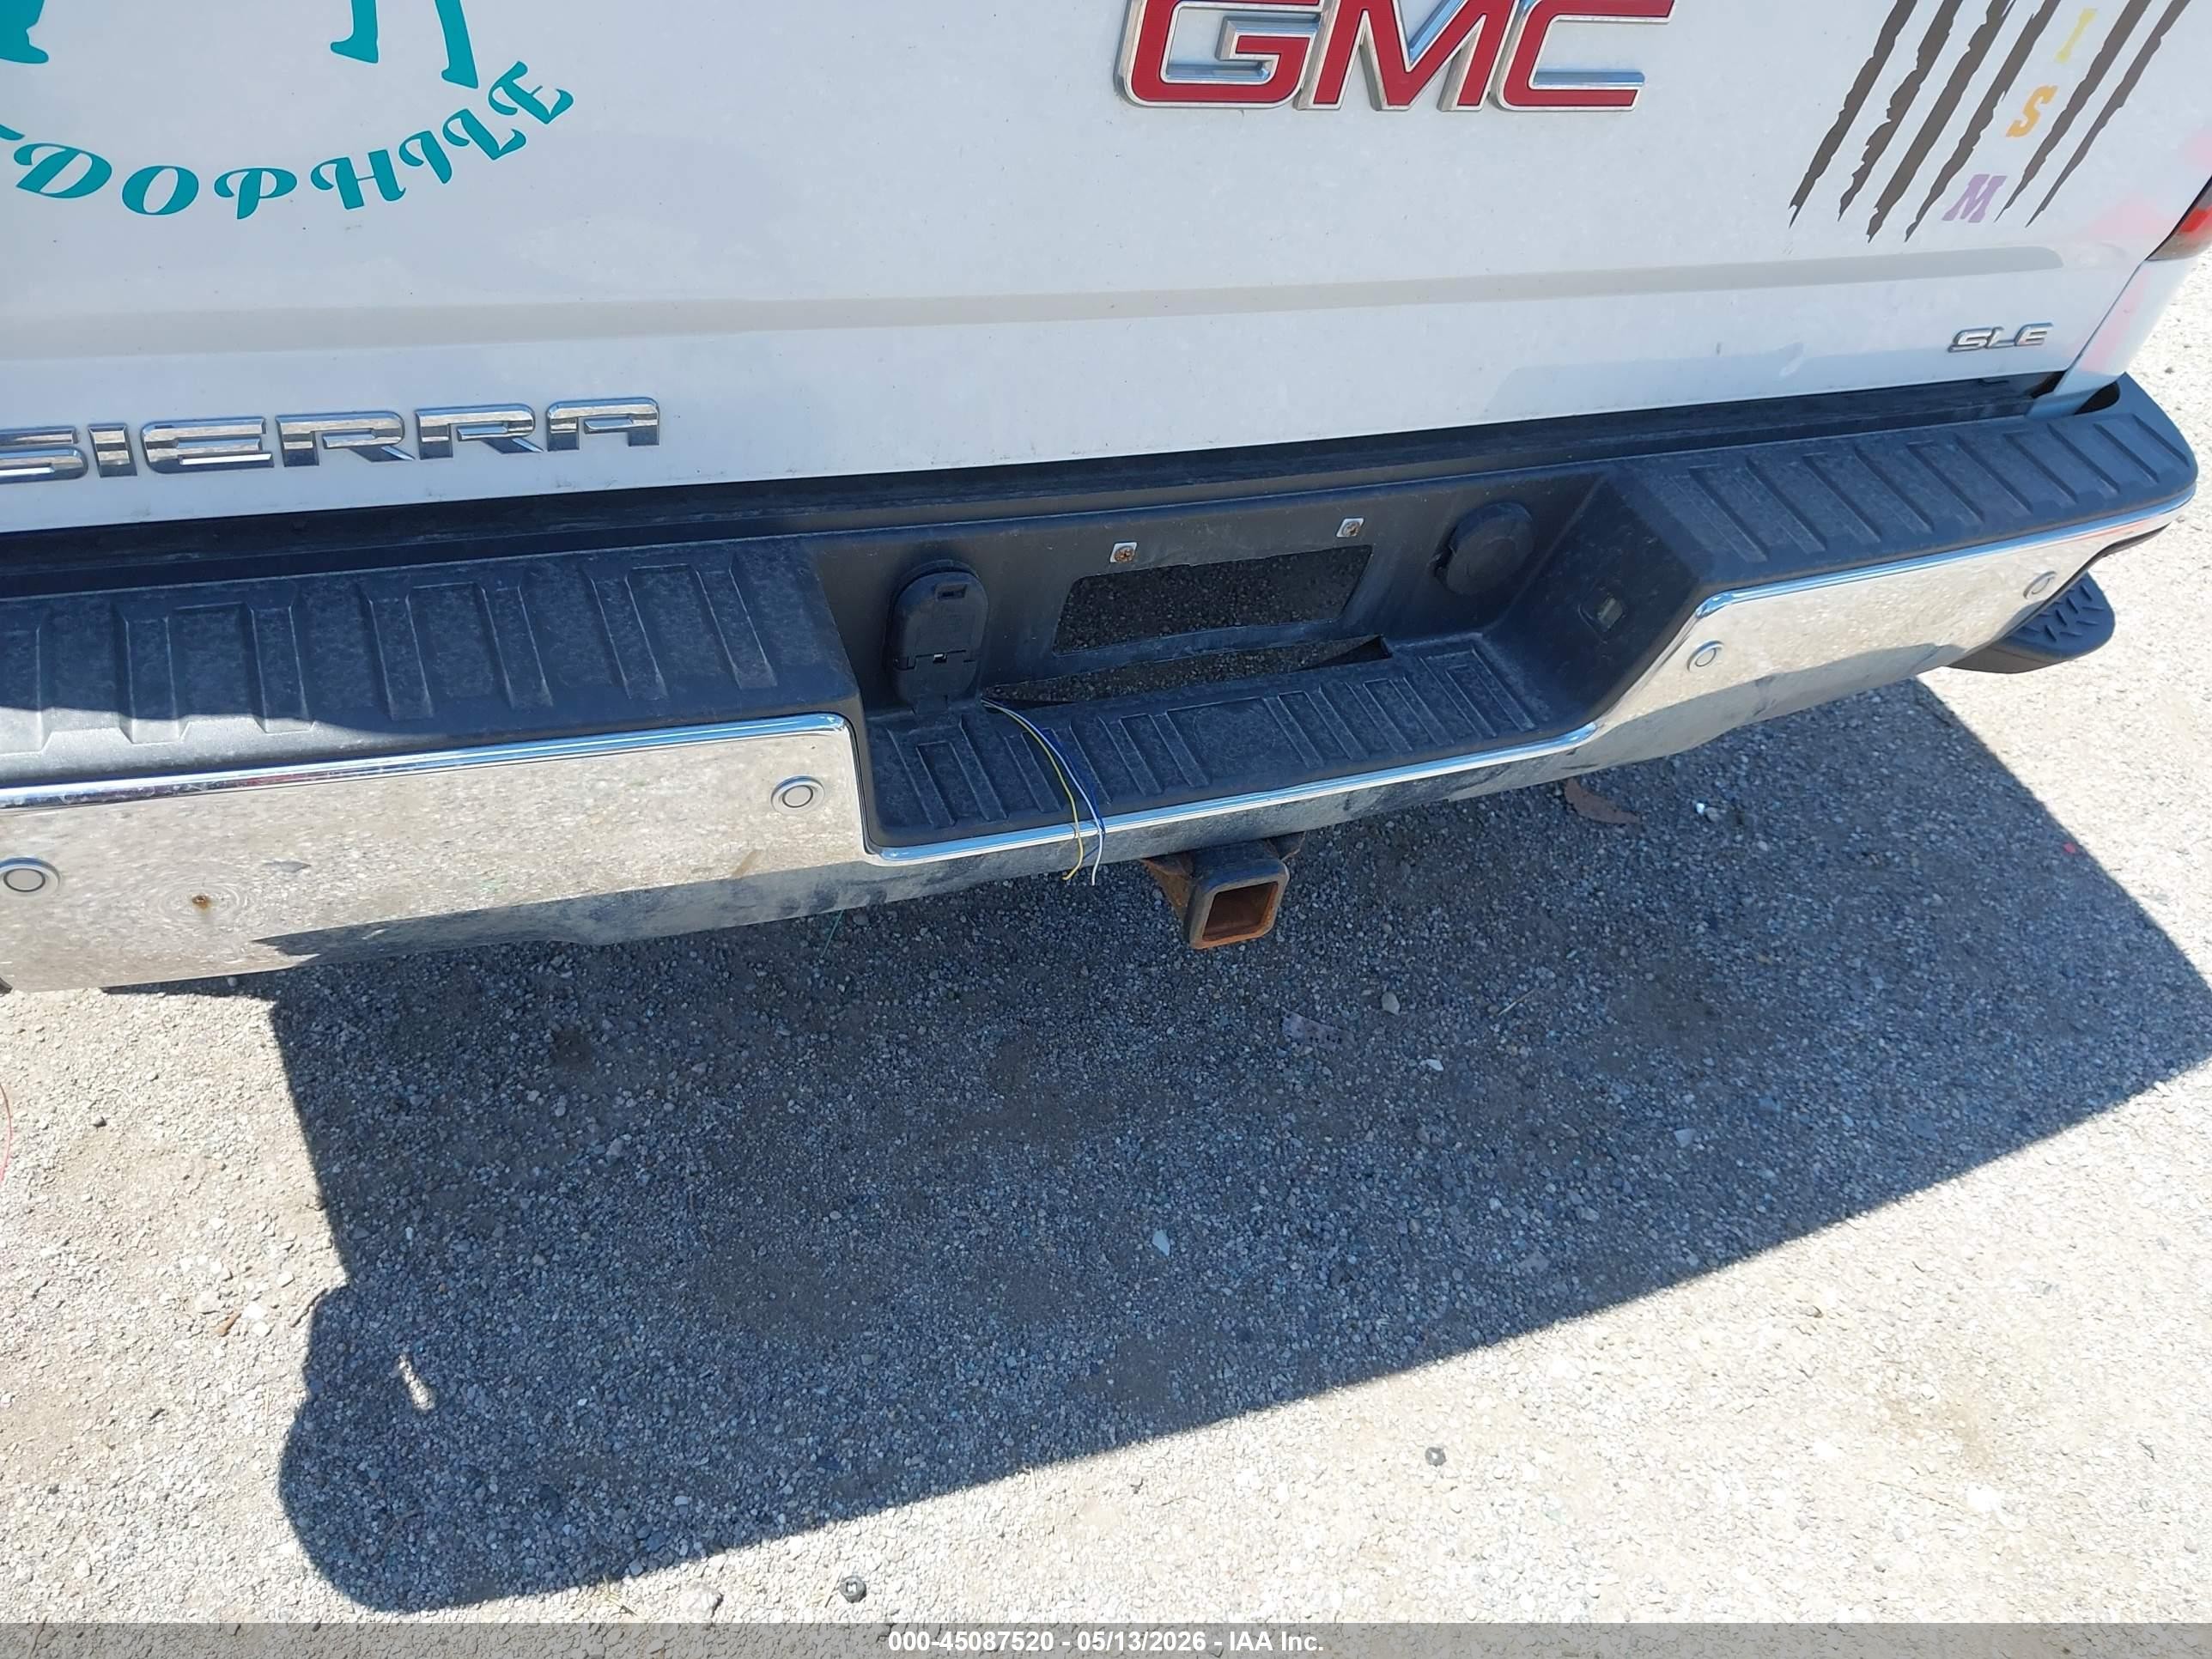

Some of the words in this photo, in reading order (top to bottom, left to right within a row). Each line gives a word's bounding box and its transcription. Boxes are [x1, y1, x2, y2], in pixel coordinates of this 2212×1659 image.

[1115, 0, 1673, 112] GMC
[0, 60, 574, 220] DOPHILE
[1948, 323, 2053, 353] SLE
[0, 397, 659, 484] SIERRA
